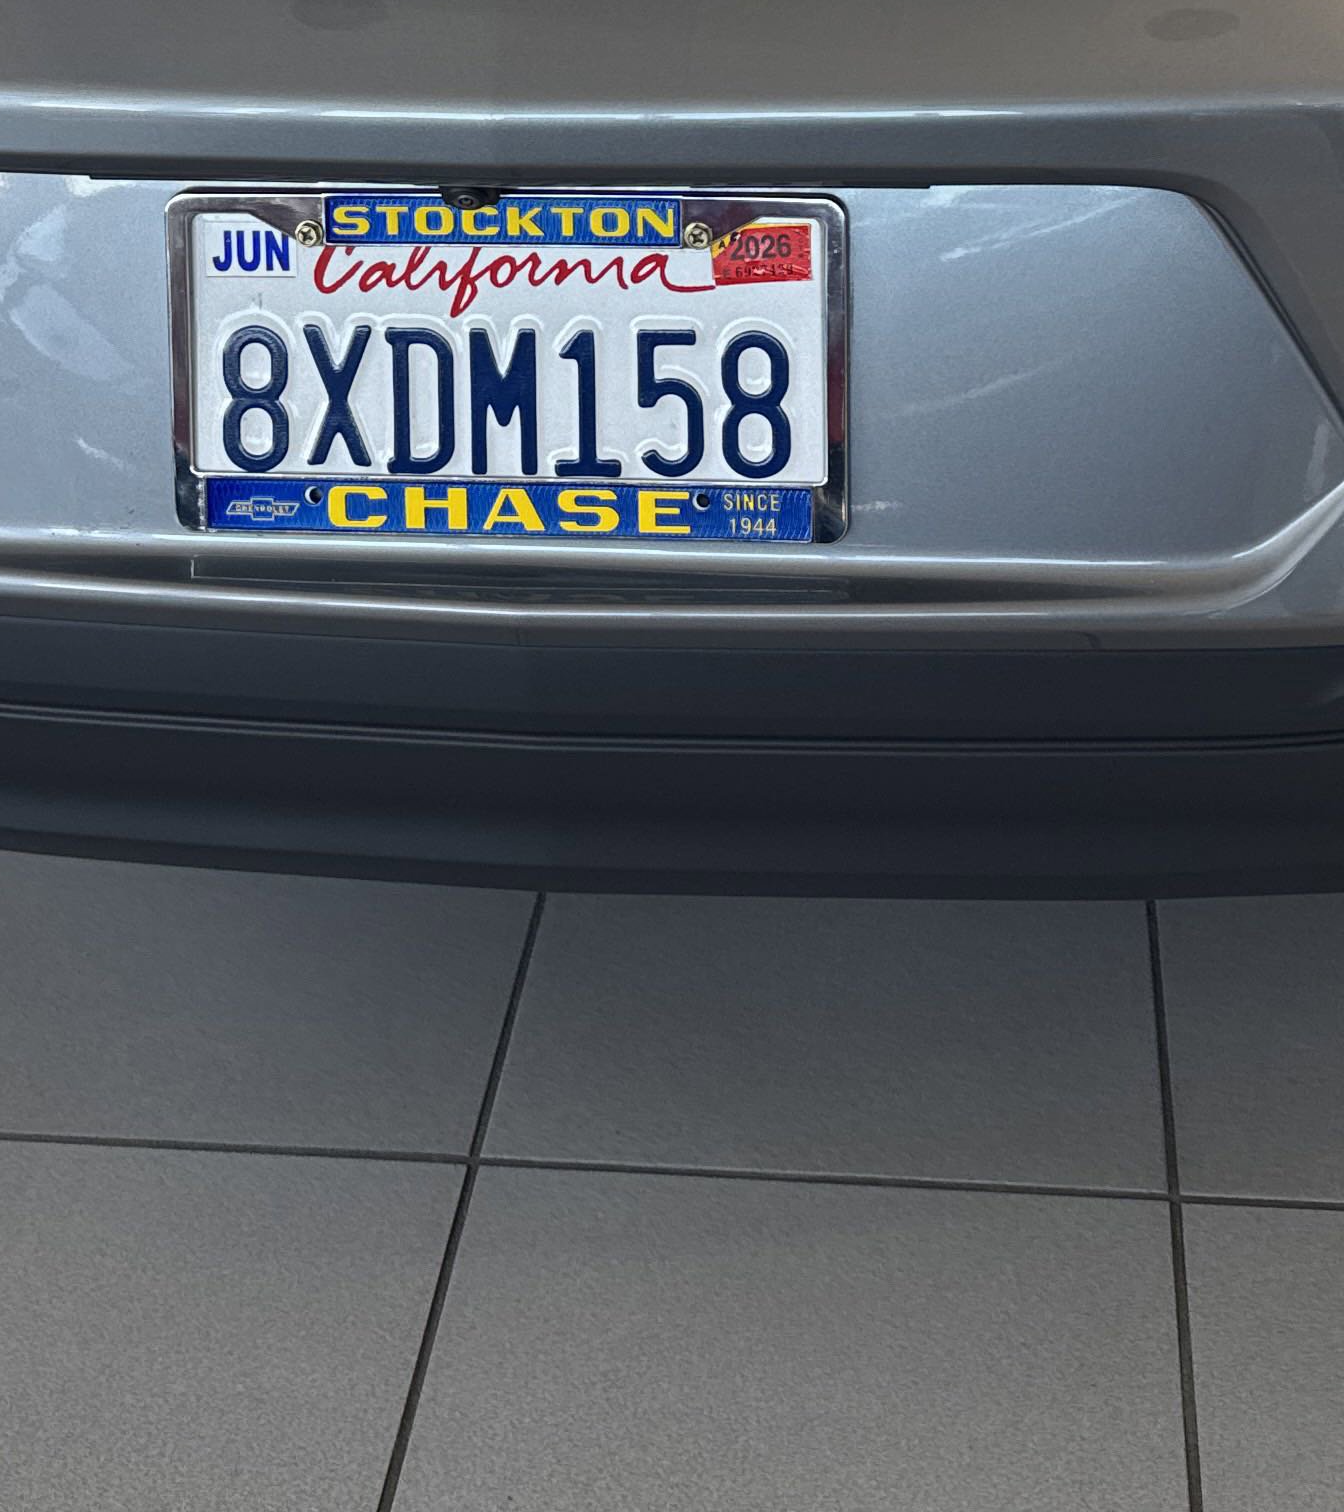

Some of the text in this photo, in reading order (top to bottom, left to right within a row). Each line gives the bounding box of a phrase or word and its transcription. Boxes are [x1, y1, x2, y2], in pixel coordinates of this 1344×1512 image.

[331, 205, 675, 237] STOCKTON
[212, 229, 290, 272] JUN
[730, 233, 792, 261] 2026
[314, 246, 716, 318] California
[222, 323, 792, 479] 8XDM158
[327, 486, 692, 535] CHASE
[723, 493, 781, 512] SINCE
[729, 517, 777, 537] 1944
